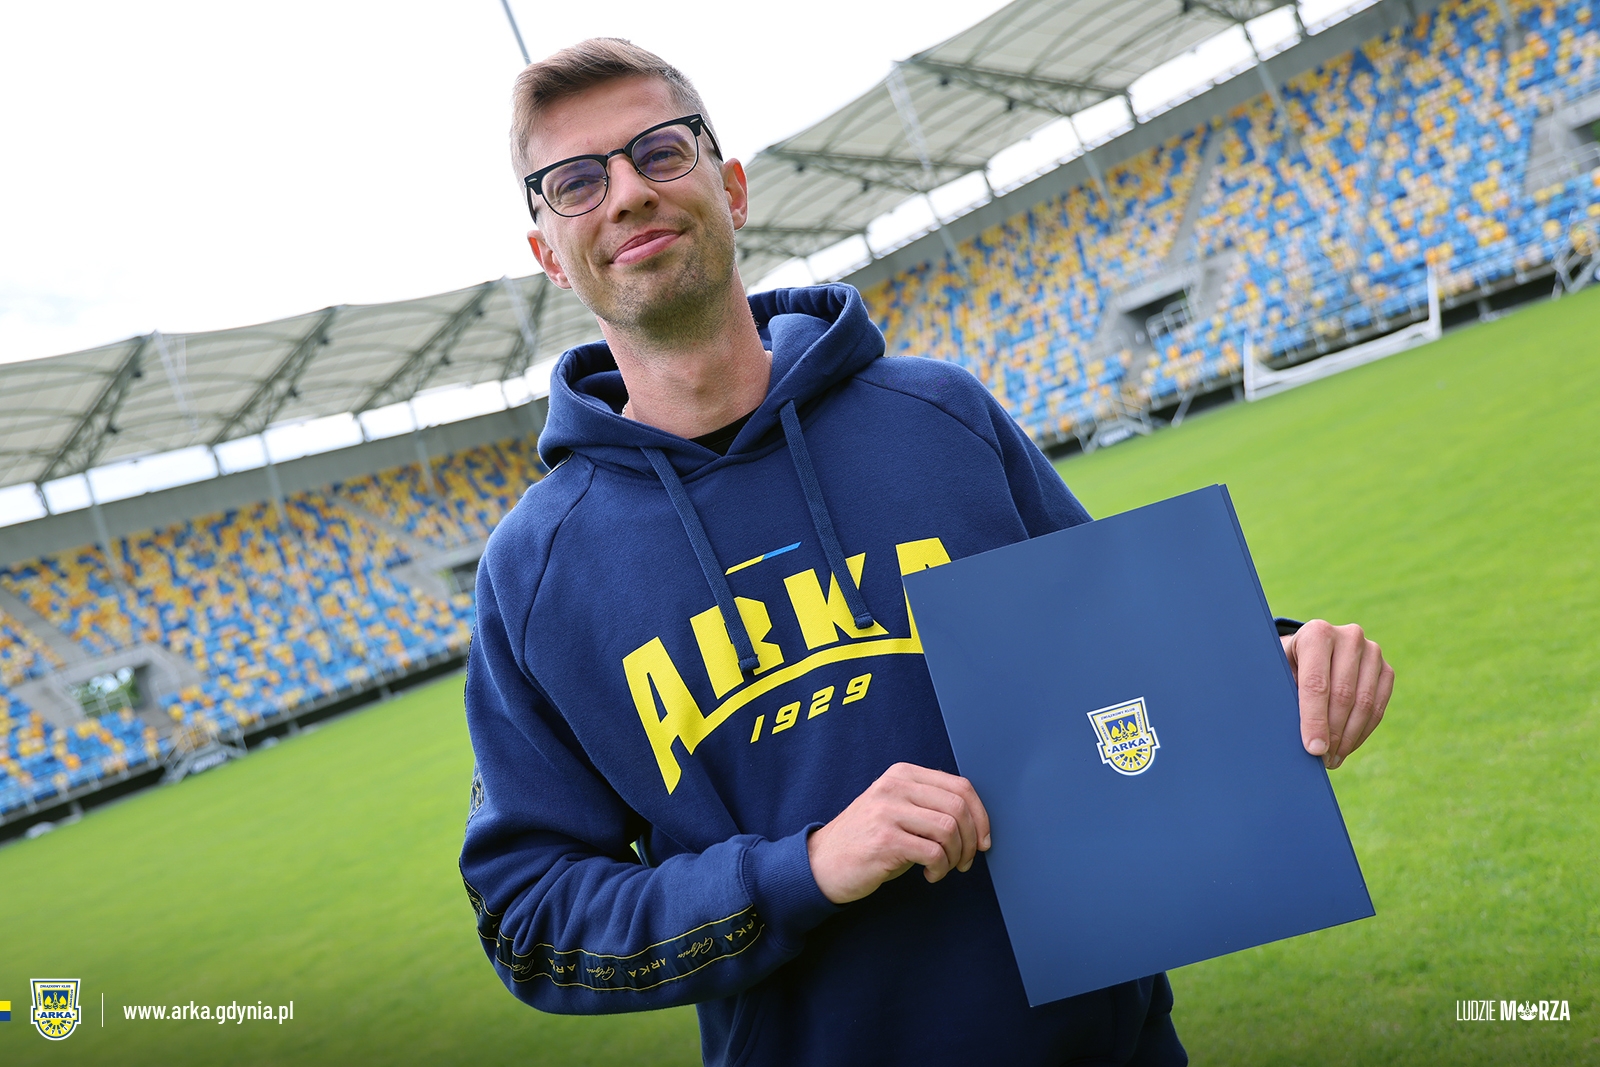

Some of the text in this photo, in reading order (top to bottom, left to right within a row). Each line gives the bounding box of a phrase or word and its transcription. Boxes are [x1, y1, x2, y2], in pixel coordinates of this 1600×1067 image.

[622, 537, 952, 795] ARK
[750, 673, 872, 743] 1929
[1112, 738, 1147, 753] ARKA
[628, 957, 666, 978] ARKA
